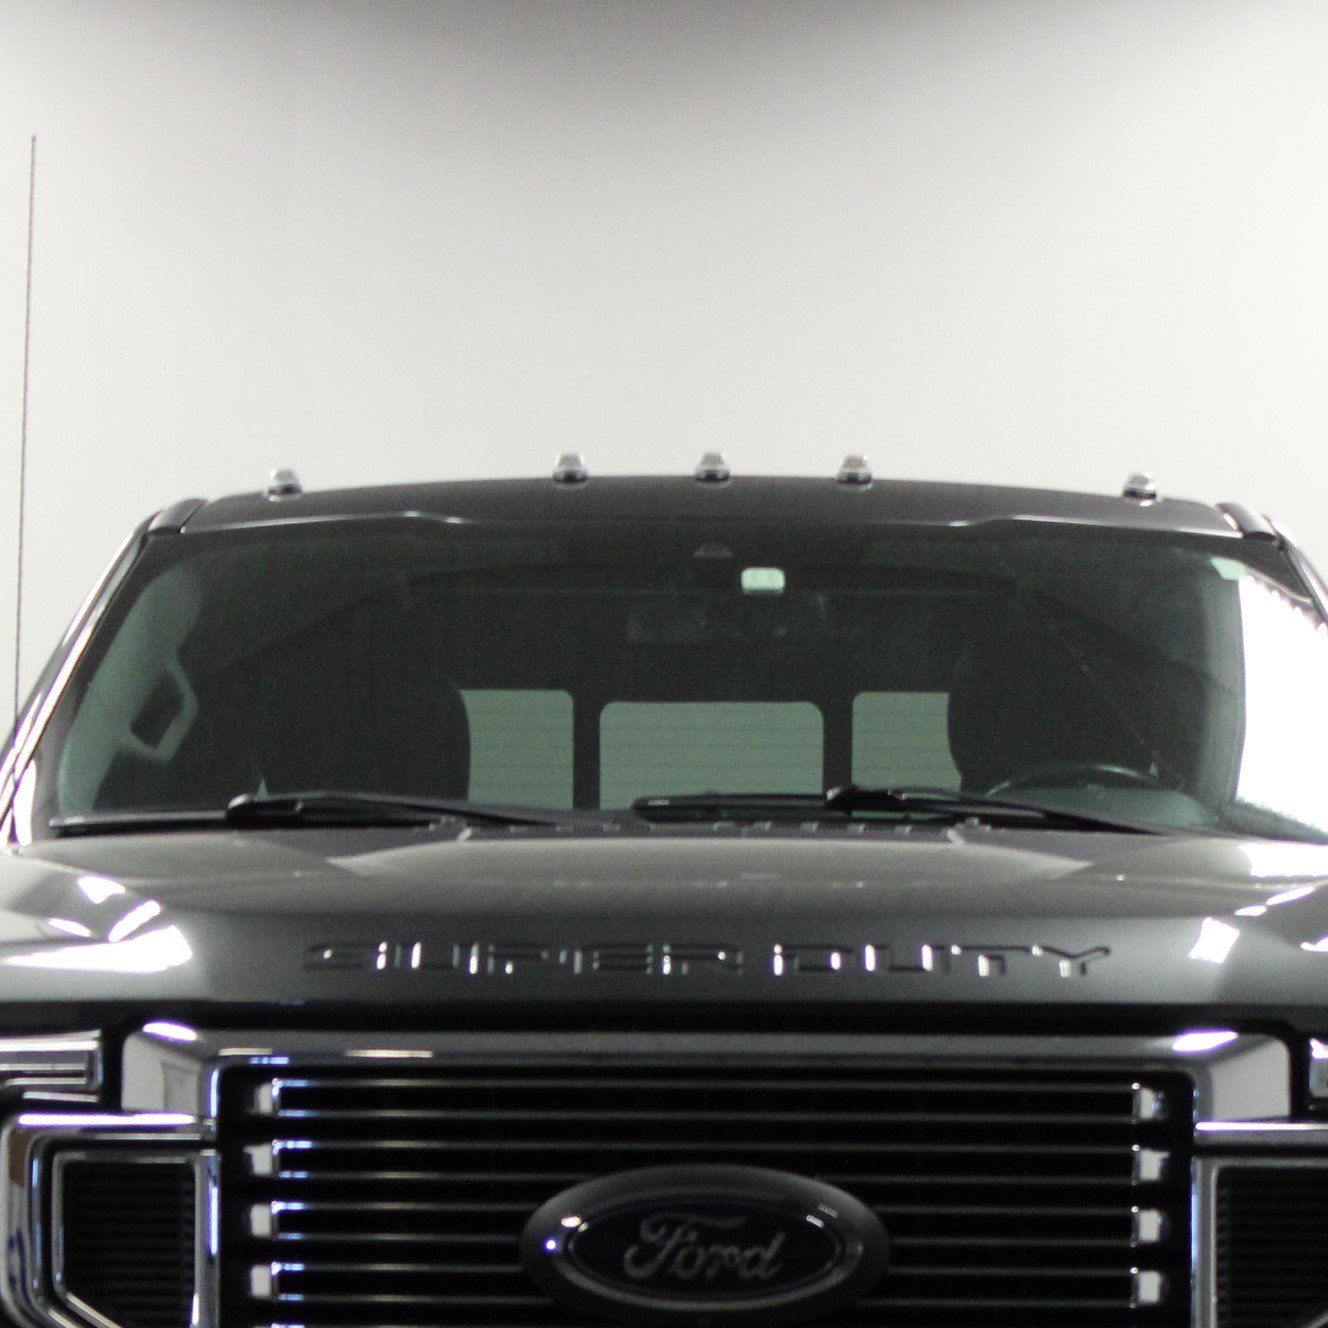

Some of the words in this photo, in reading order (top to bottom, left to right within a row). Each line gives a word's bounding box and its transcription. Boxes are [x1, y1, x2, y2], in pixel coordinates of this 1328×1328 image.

[304, 941, 745, 976] SUPER
[772, 943, 1111, 978] DUTY
[623, 1211, 786, 1280] Ford
